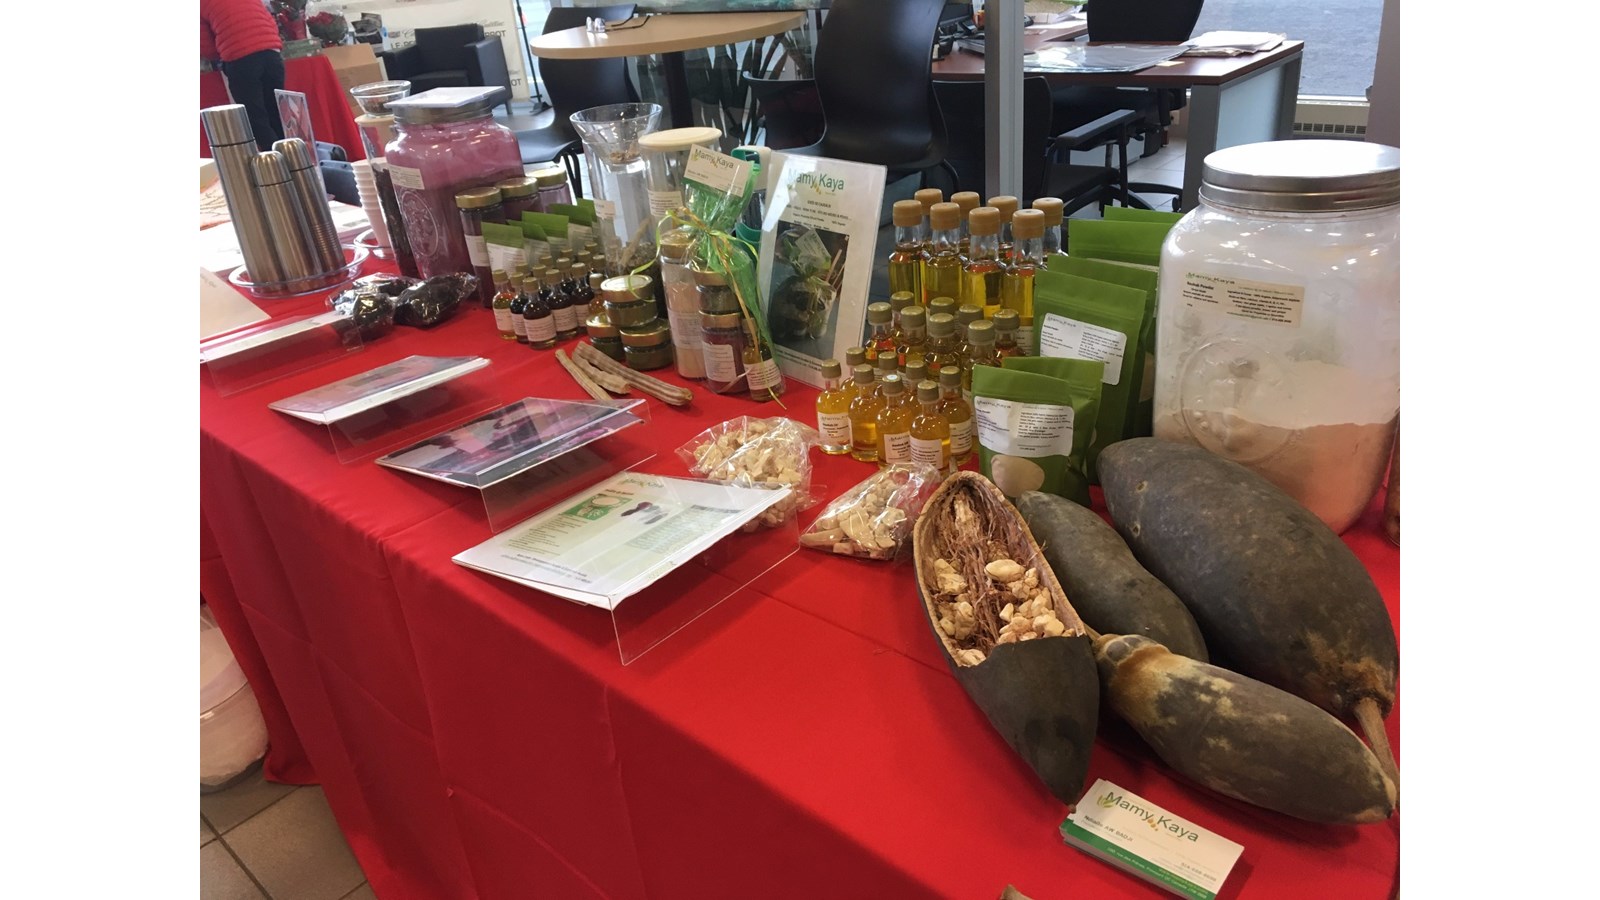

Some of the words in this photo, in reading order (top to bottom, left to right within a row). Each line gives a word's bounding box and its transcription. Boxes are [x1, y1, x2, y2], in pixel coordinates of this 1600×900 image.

[717, 156, 734, 169] Kaya
[818, 173, 845, 192] Kaya
[1105, 791, 1154, 822] Mamy
[1157, 815, 1200, 842] Kaya
